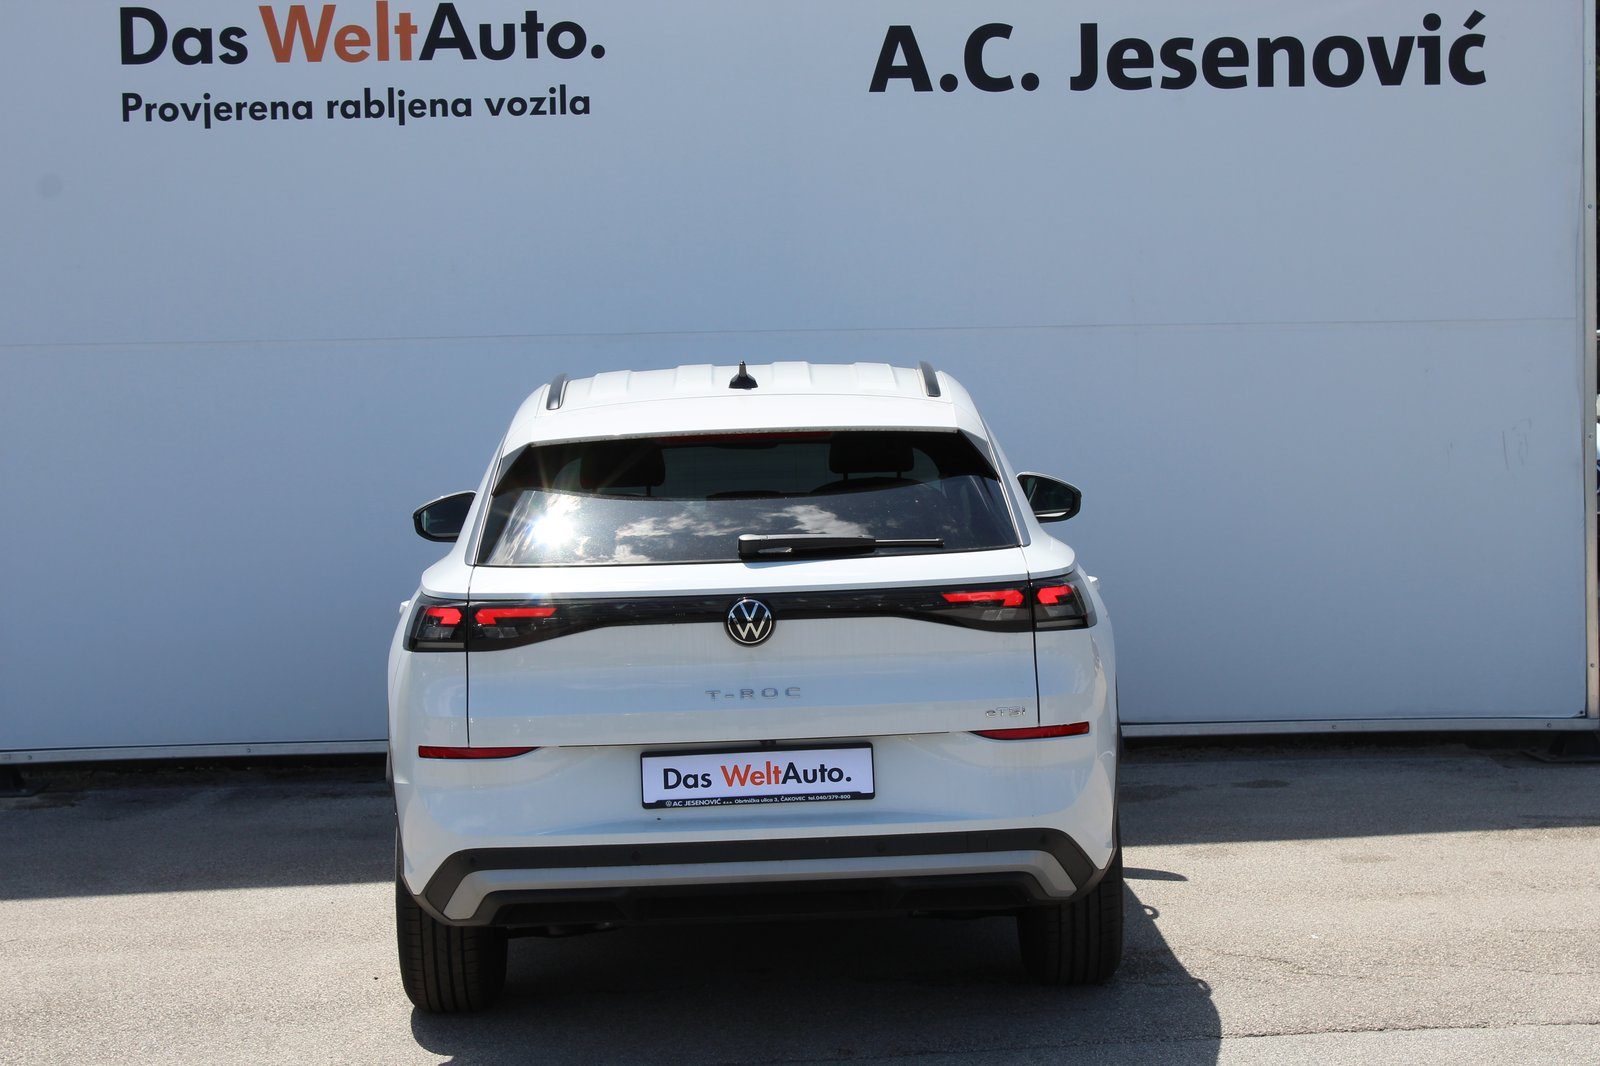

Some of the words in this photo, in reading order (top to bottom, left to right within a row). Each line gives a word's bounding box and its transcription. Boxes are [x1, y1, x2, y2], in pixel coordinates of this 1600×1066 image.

[120, 7, 249, 66] Das
[258, 0, 606, 64] WeltAuto.
[868, 22, 1040, 93] A.C.
[1069, 9, 1487, 92] Jesenović
[121, 92, 313, 129] Provjerena
[326, 87, 473, 126] rabljena
[484, 84, 591, 117] vozila
[705, 687, 801, 702] T-ROC
[663, 767, 712, 790] Das
[720, 760, 852, 787] WeltAuto.
[684, 798, 721, 806] JESENOVIĆ
